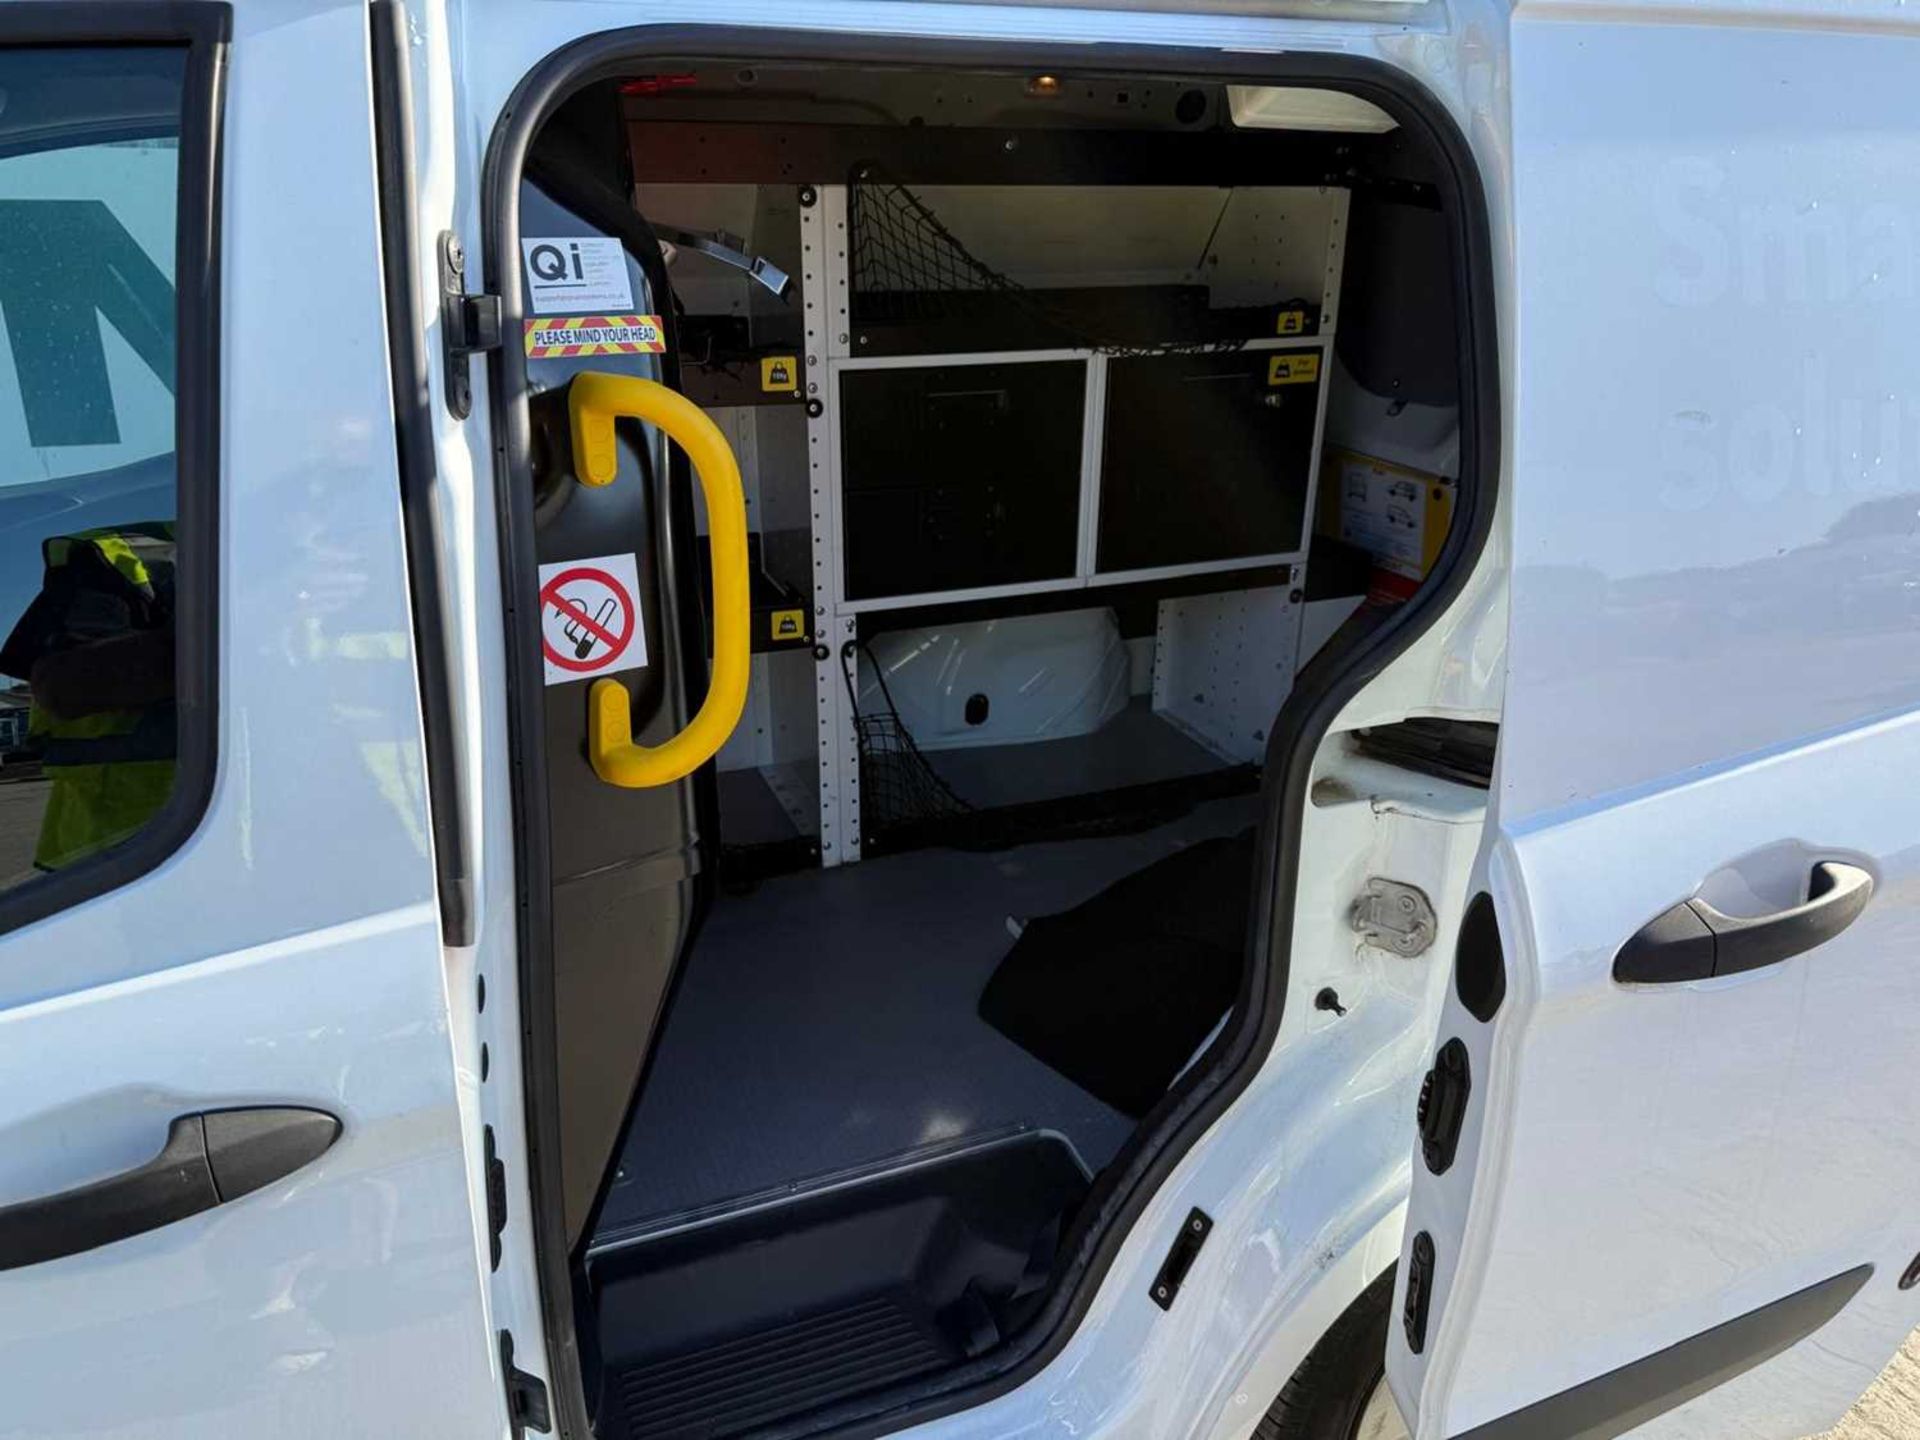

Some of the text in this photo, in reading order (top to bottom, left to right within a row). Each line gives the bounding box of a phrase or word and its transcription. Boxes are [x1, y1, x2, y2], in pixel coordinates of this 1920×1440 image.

[530, 243, 584, 281] Qi
[534, 327, 655, 345] PLEASE MIND YOUR HEAD
